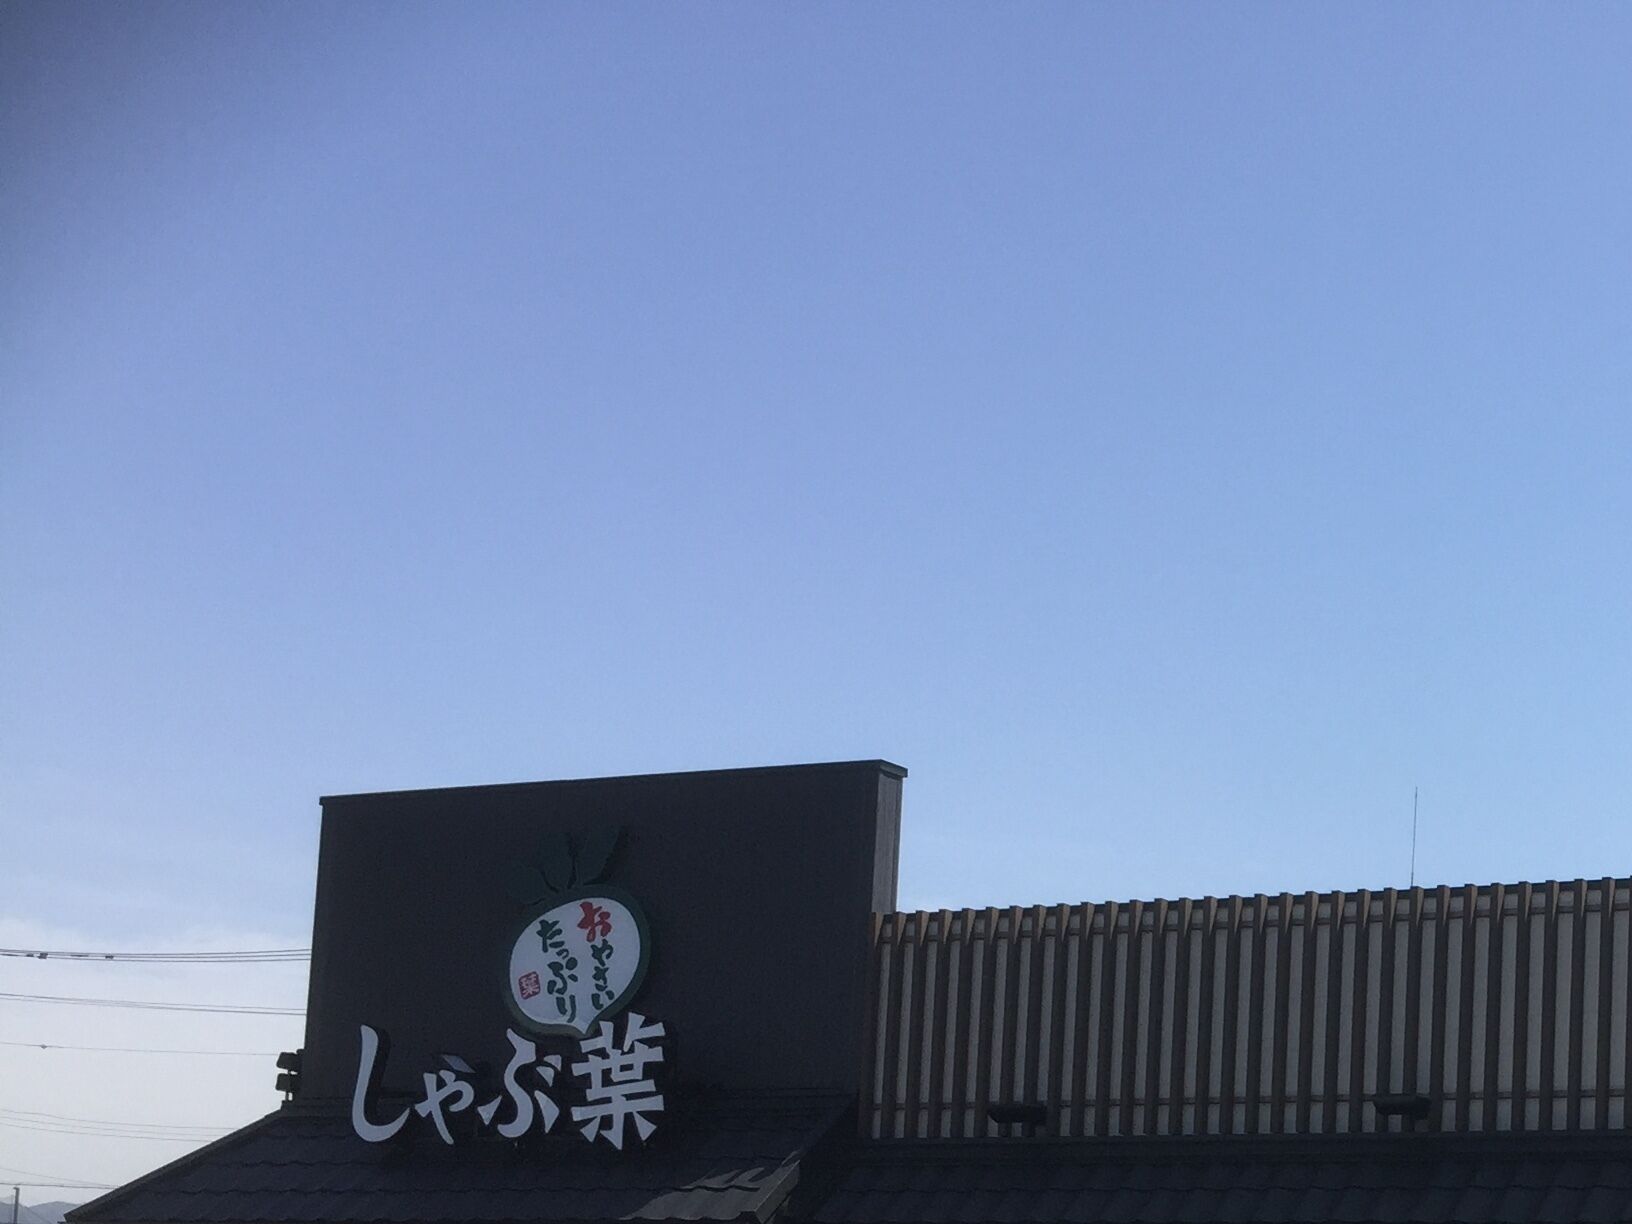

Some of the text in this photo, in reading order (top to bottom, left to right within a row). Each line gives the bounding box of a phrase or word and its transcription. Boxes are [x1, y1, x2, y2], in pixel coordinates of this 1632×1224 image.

[536, 919, 578, 1023] たっぷり
[577, 901, 614, 1011] おやさい
[352, 1012, 666, 1150] しゃぶ葉
